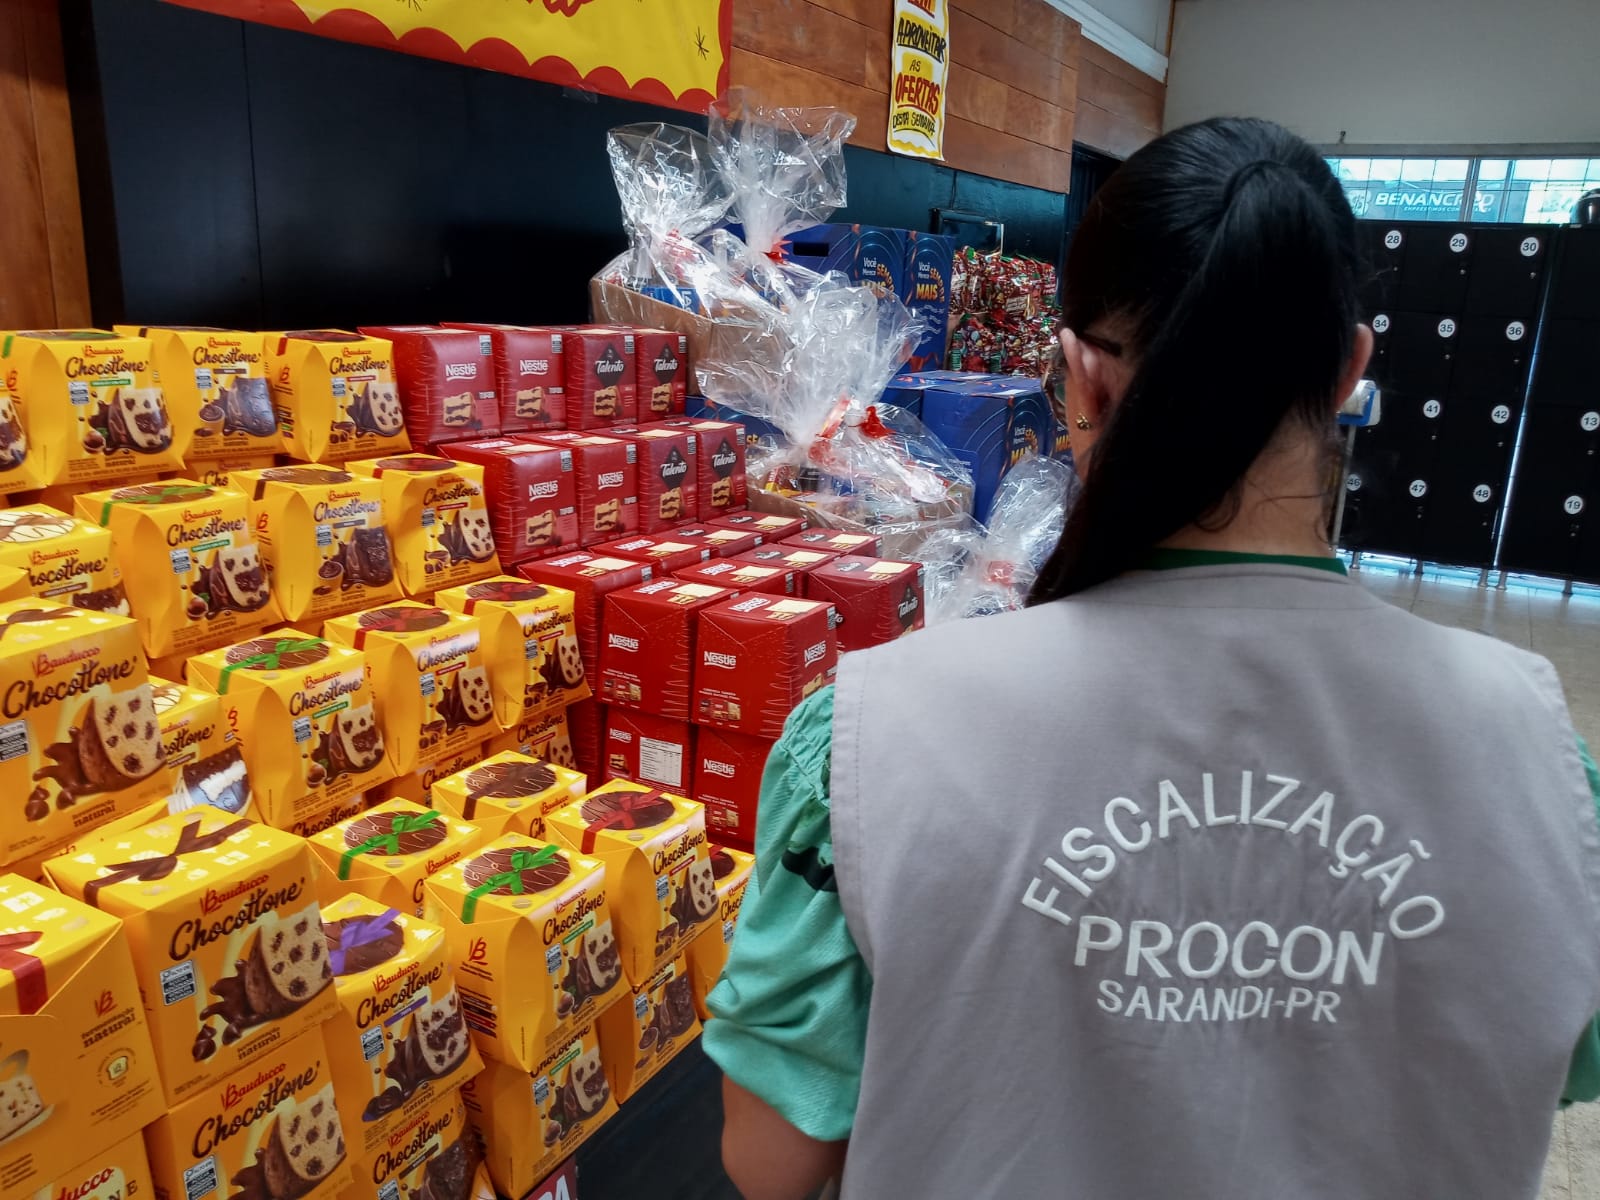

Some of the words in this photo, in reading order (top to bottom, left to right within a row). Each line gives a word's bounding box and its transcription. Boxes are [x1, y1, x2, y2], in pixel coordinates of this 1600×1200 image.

[909, 59, 921, 72] AS
[895, 72, 941, 115] OFERTAS
[893, 112, 910, 129] DESTA
[911, 112, 936, 136] SEMANA
[1386, 235, 1400, 244] 28
[1452, 238, 1465, 247] 29
[1522, 242, 1537, 251] 30
[916, 283, 939, 300] MAIS
[1374, 319, 1388, 328] 34
[1440, 324, 1453, 332] 35
[1508, 326, 1522, 335] 36
[193, 346, 262, 366] Chocottone
[329, 355, 388, 375] Chocottone
[653, 358, 679, 372] Talento
[65, 355, 147, 378] Chocottone
[595, 359, 625, 375] Talento
[1425, 405, 1439, 414] 41
[1493, 410, 1508, 419] 42
[1583, 417, 1598, 426] 13
[660, 461, 687, 478] Talento
[711, 451, 738, 469] Talento
[1411, 484, 1425, 493] 47
[1475, 489, 1490, 498] 48
[1566, 500, 1581, 510] 19
[167, 516, 244, 546] Chocottone
[2, 657, 136, 719] Chocottone
[289, 679, 363, 716] Chocottone
[653, 832, 706, 876] Chocottone
[1021, 769, 1445, 939] FISCALIZAÇÃO
[201, 874, 270, 914] Bauducco
[168, 882, 305, 961] Chocottone
[543, 893, 606, 946] Chocottone
[1073, 914, 1385, 986] PROCON
[372, 961, 420, 993] Bauducco
[356, 964, 443, 1029] Chocottone
[1096, 979, 1342, 1023] SARANDI-PR
[221, 1062, 287, 1111] Bauducco
[191, 1066, 319, 1159] Chocottone
[373, 1110, 453, 1184] Chocottone
